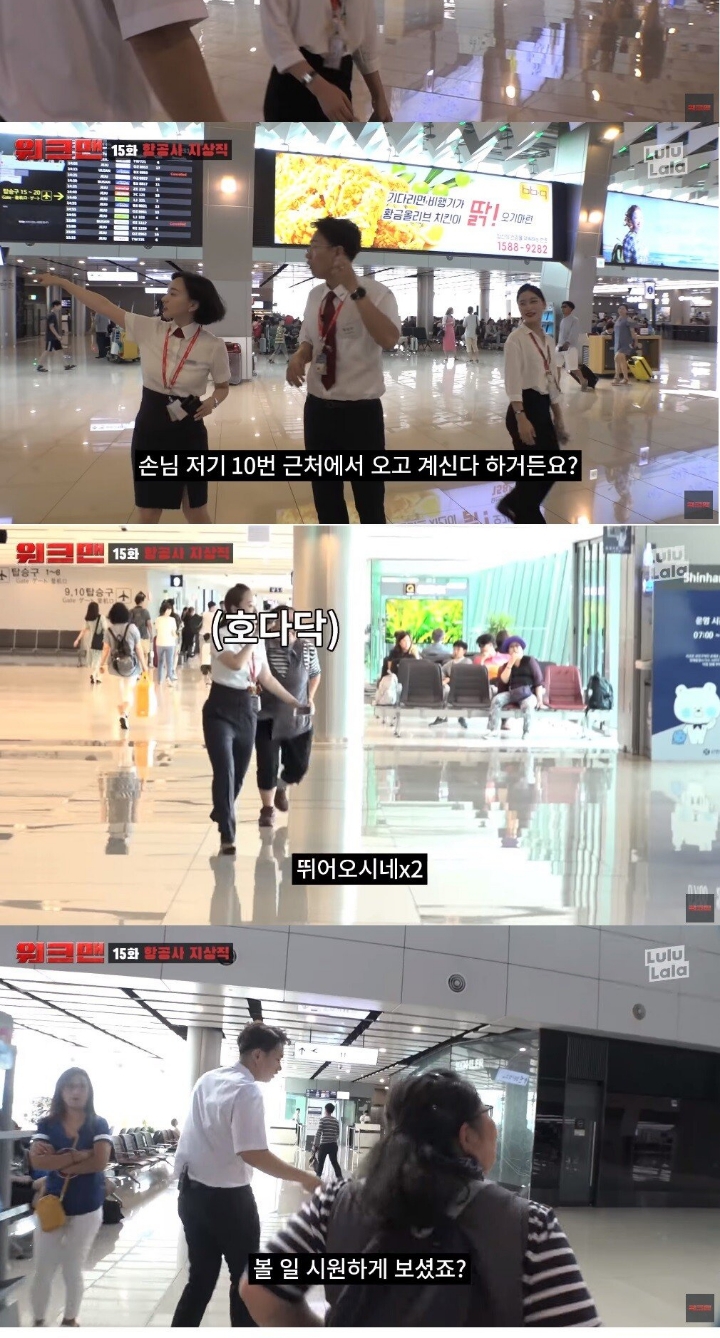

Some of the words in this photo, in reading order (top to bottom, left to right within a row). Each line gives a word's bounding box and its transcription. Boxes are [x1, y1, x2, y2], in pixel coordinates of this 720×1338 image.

[387, 191, 427, 206] 기다리면
[427, 195, 465, 209] 비행기가
[382, 208, 432, 223] 황금올리브
[433, 212, 462, 225] 치킨이
[497, 241, 548, 254] 1588-9282
[11, 567, 40, 577] 탑승구
[693, 630, 714, 640] 07:00
